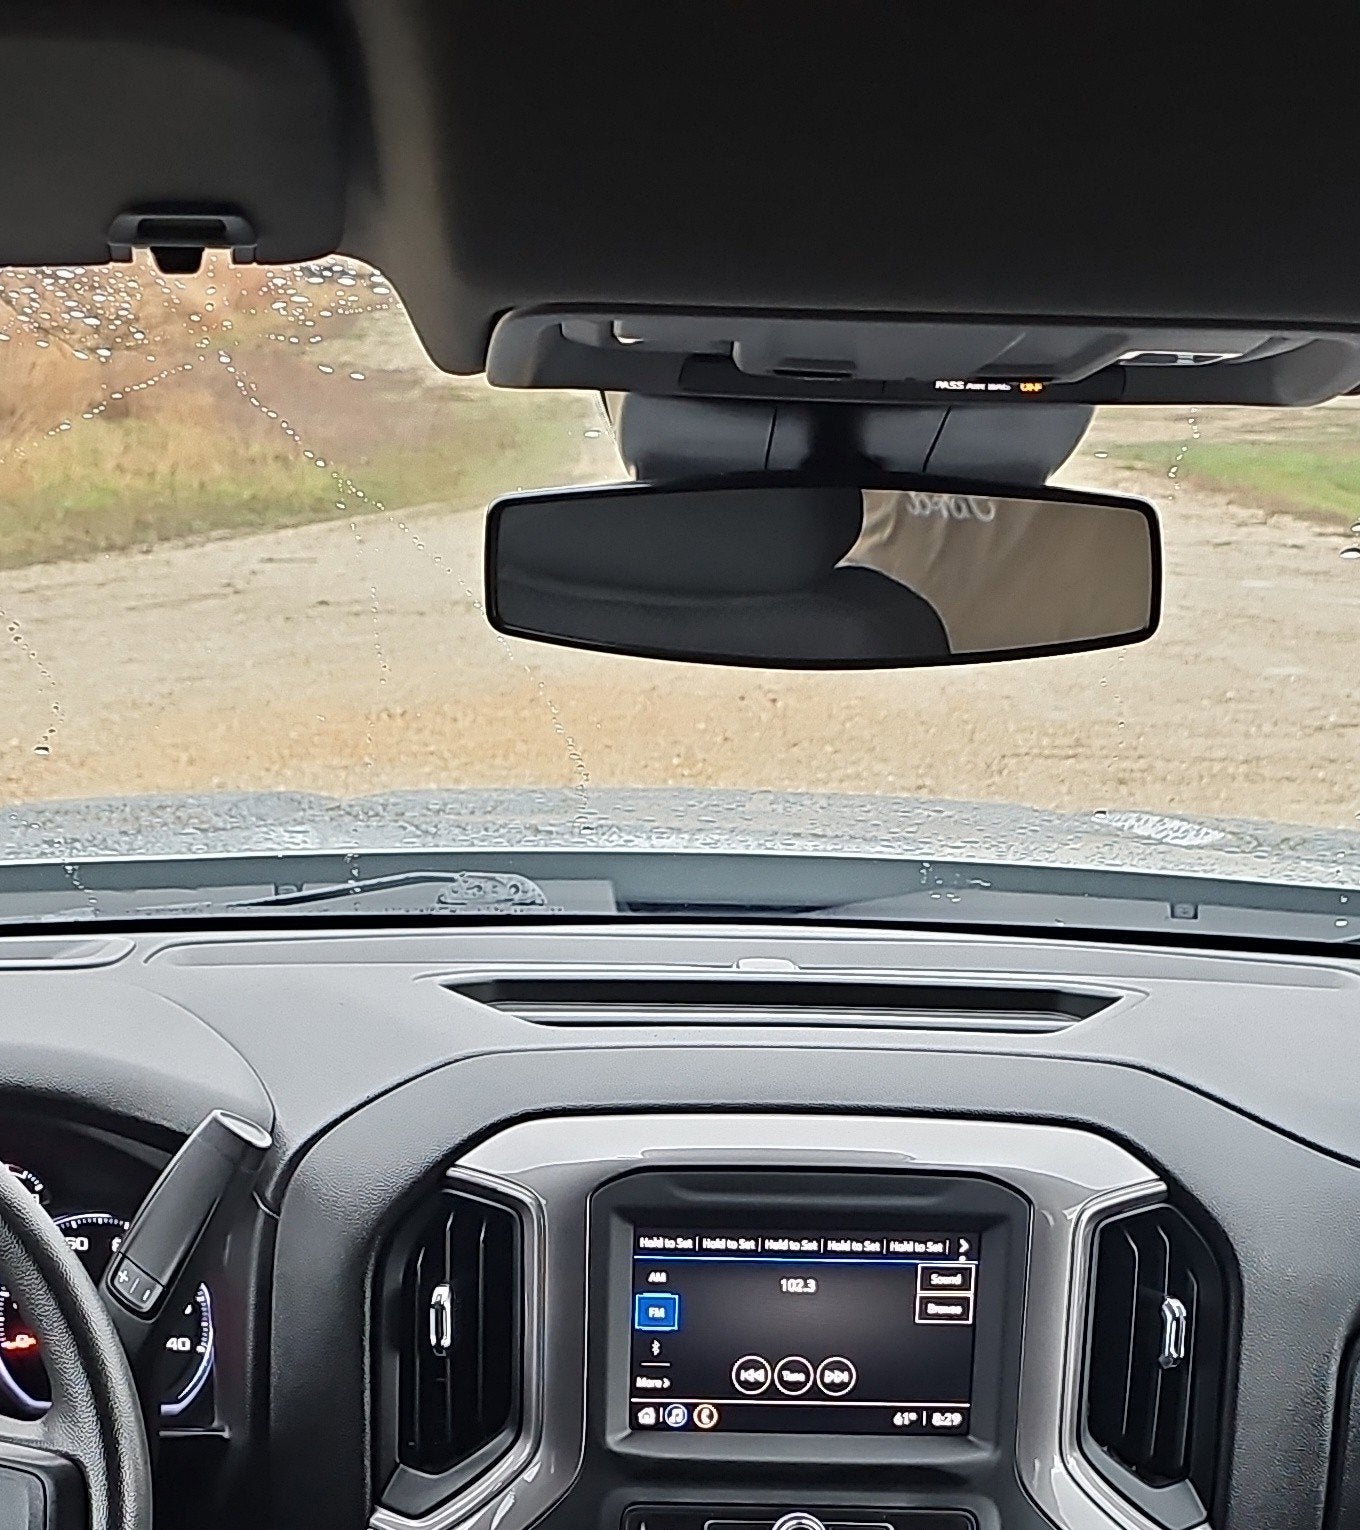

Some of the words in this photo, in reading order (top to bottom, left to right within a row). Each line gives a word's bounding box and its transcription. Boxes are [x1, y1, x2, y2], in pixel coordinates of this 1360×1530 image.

[935, 380, 965, 390] PASS
[965, 382, 986, 390] AIR
[987, 383, 1012, 391] BAG
[640, 1237, 664, 1248] Hold
[665, 1238, 676, 1249] to
[676, 1237, 694, 1249] Set
[702, 1238, 726, 1249] Hold
[727, 1239, 738, 1250] to
[738, 1238, 756, 1250] Set
[765, 1239, 789, 1250] Hold
[789, 1240, 801, 1250] to
[801, 1239, 818, 1251] Set
[827, 1239, 851, 1251] Hold
[852, 1240, 862, 1251] to
[863, 1240, 881, 1252] Set
[890, 1241, 914, 1252] Hold
[915, 1241, 926, 1252] to
[926, 1241, 943, 1253] Set
[647, 1271, 667, 1283] AM
[930, 1273, 962, 1285] Sound
[779, 1278, 817, 1293] 102.3
[648, 1307, 665, 1319] FM
[635, 1376, 663, 1389] More
[931, 1412, 963, 1427] 8:29
